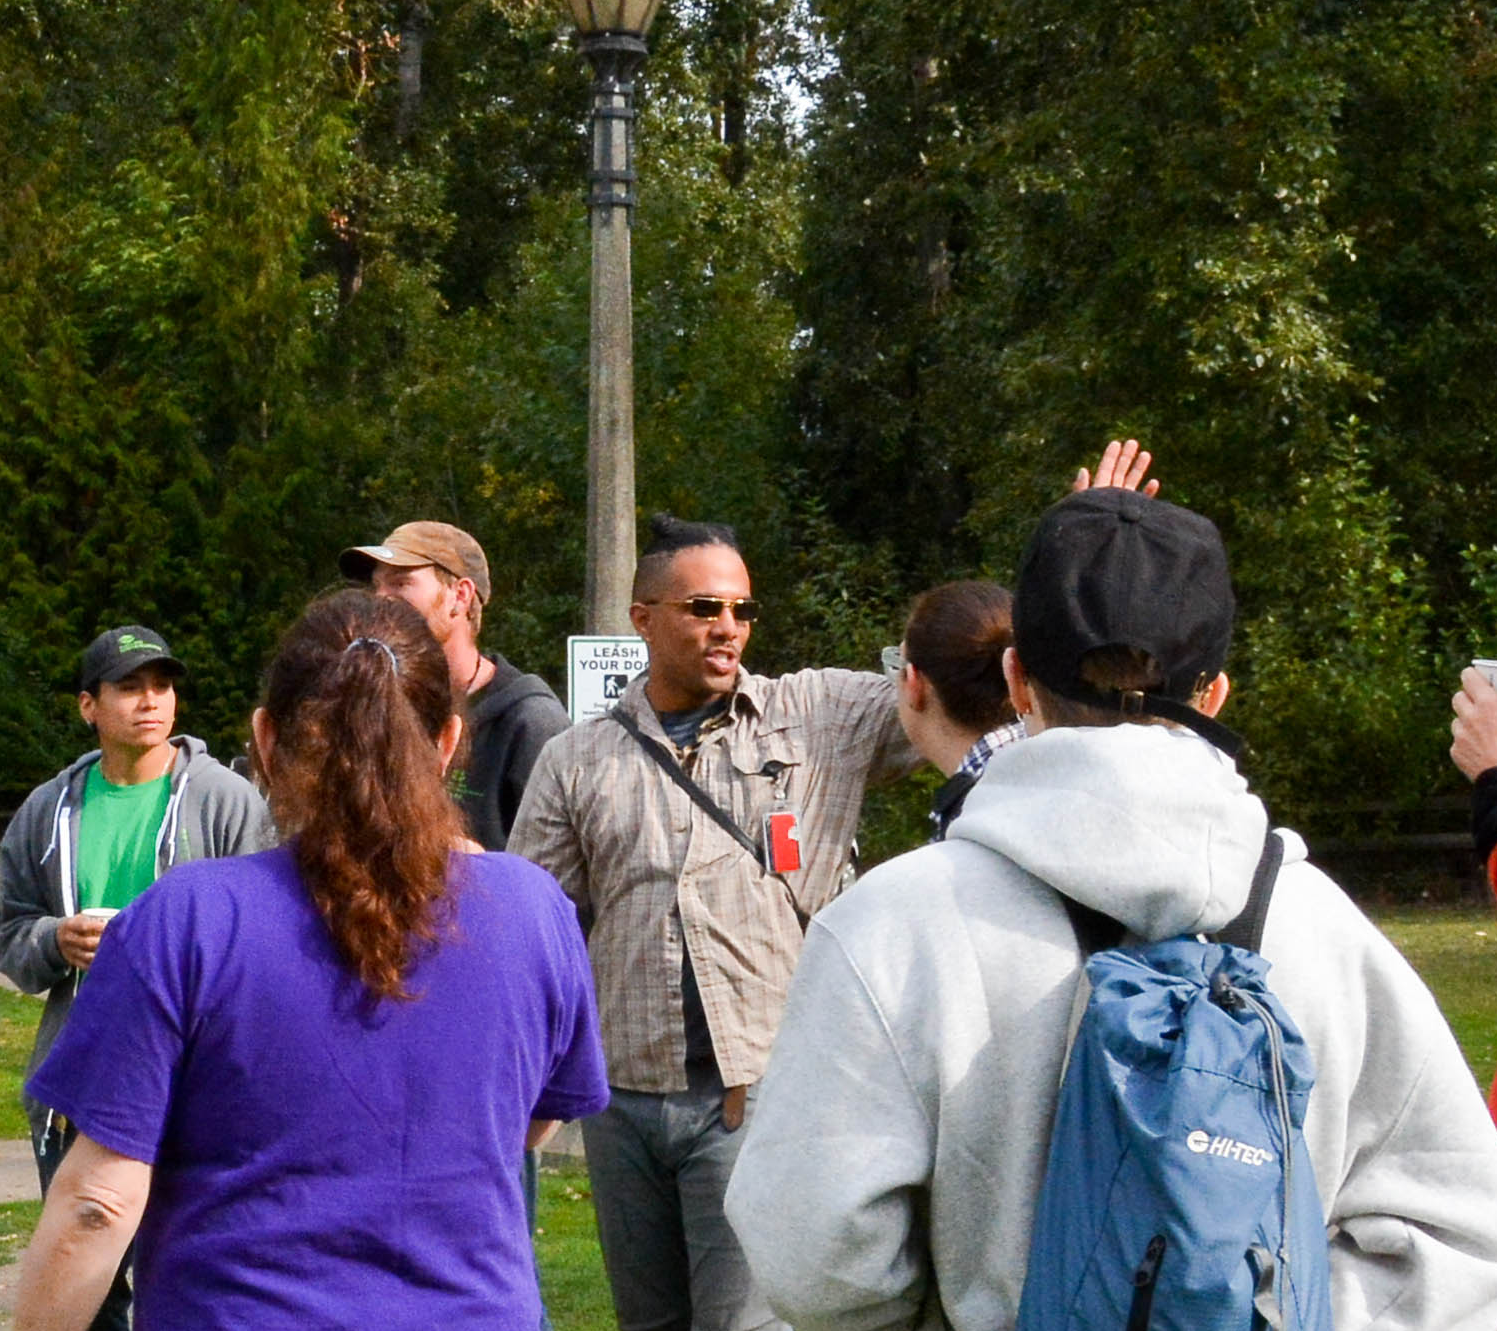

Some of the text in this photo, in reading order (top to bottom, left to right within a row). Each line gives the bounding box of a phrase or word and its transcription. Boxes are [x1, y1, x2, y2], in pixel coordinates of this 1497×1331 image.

[593, 646, 639, 658] LEASH
[579, 660, 619, 670] YOUR
[1209, 1136, 1265, 1166] HI-TEC
